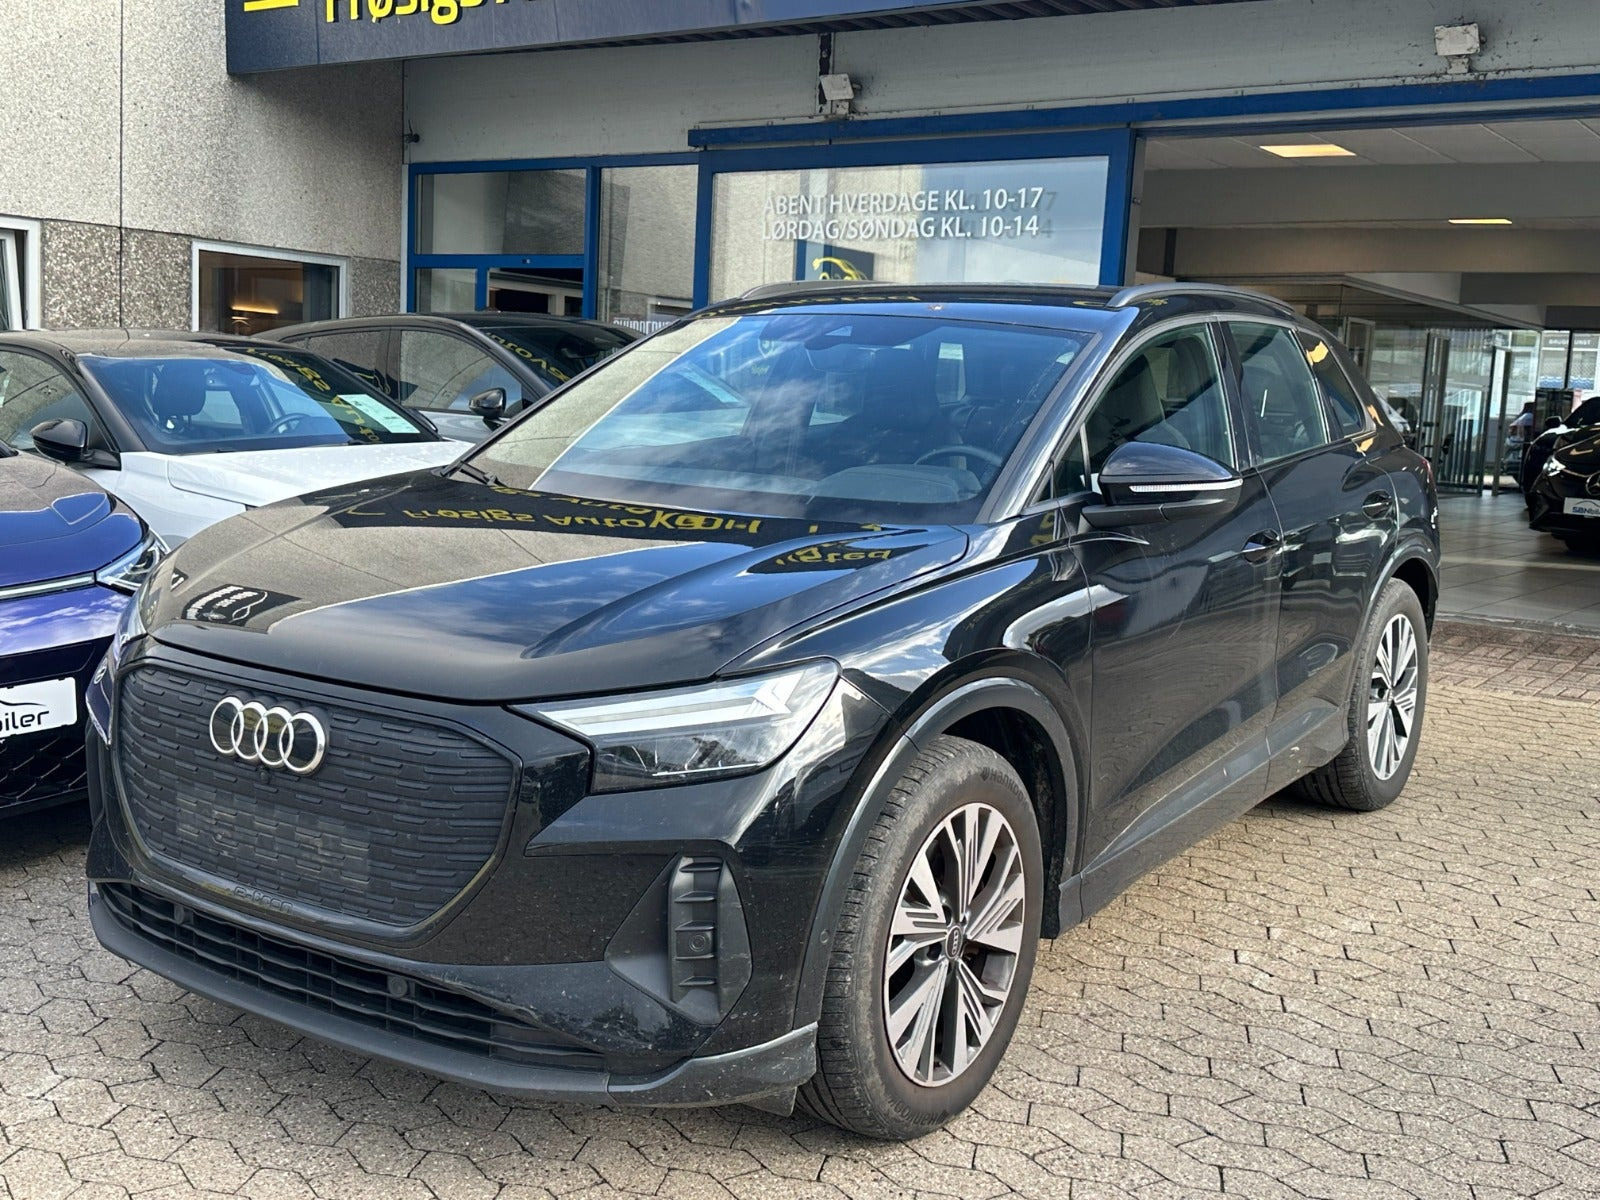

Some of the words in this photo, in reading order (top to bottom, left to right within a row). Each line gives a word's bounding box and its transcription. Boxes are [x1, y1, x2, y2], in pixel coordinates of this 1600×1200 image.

[830, 190, 939, 214] HVERDAGE
[945, 189, 976, 211] KL.
[983, 187, 1043, 210] 10-17
[762, 216, 935, 240] LØRDAG/SØNDAG
[940, 216, 971, 238] KL.
[982, 215, 1039, 237] 10-14
